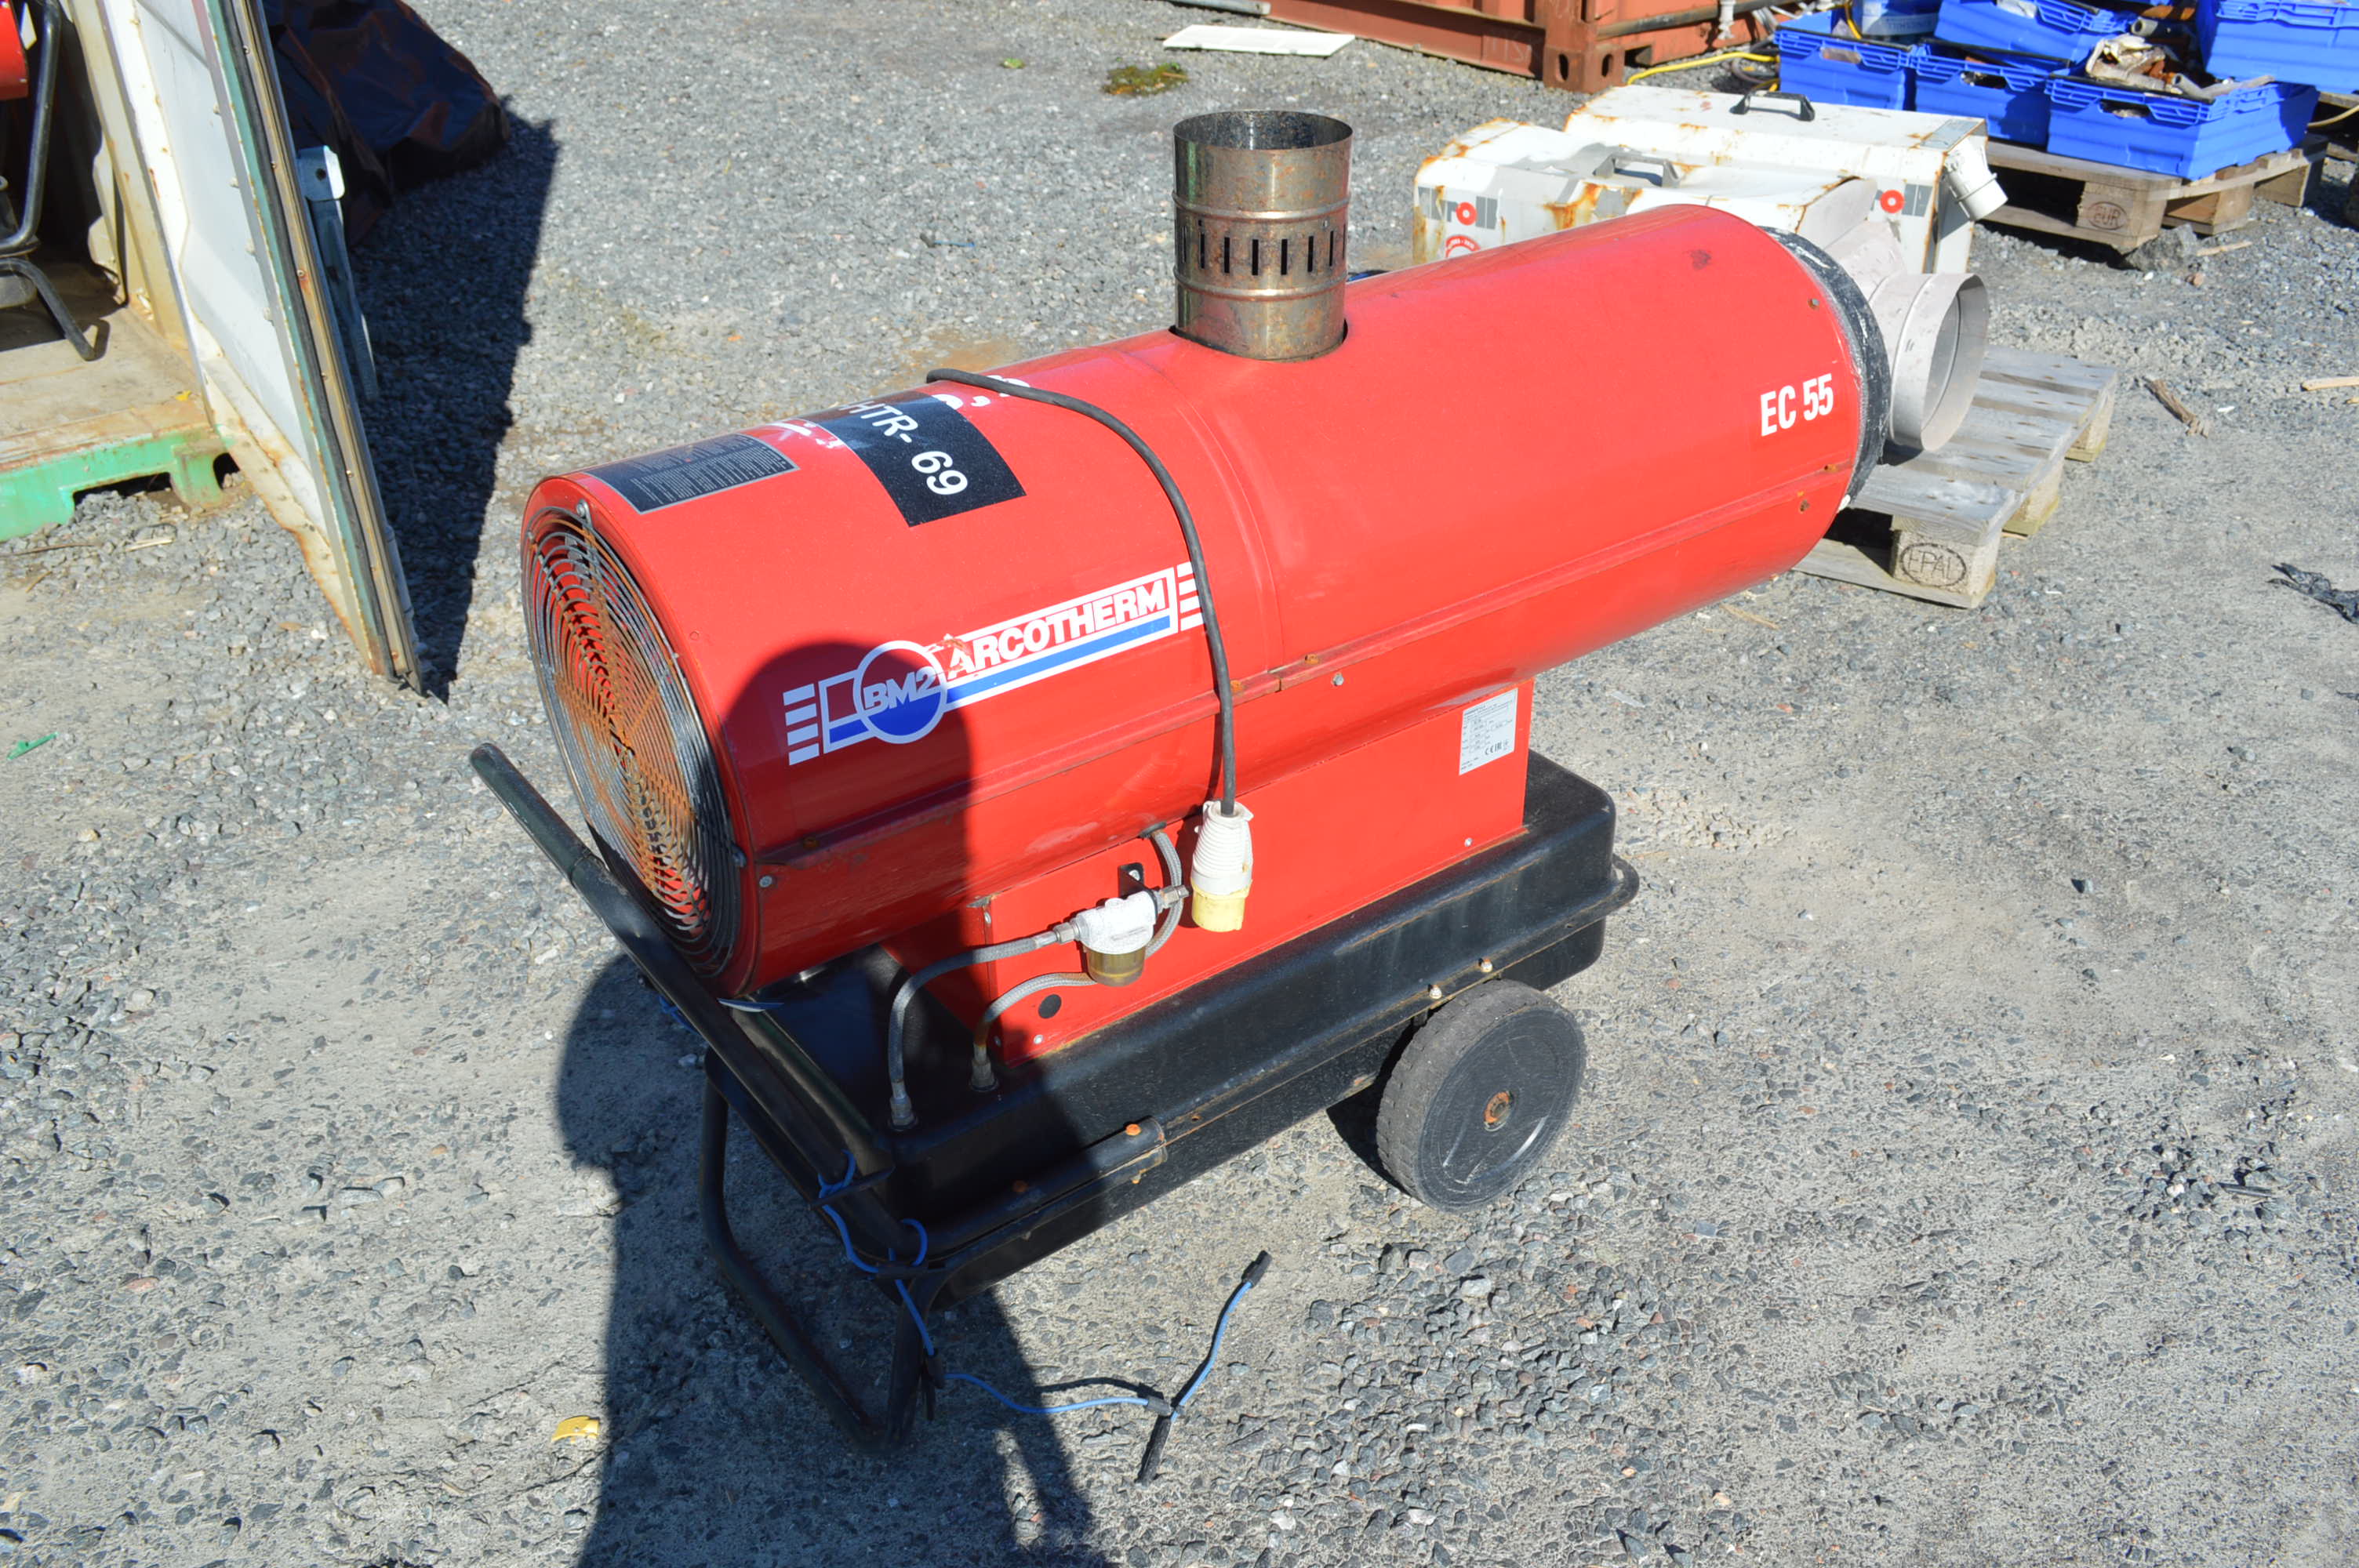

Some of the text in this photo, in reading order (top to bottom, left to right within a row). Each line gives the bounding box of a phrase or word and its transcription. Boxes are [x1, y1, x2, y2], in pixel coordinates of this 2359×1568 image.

[2094, 206, 2121, 227] EUR
[1761, 372, 1834, 437] EC 55
[911, 451, 968, 495] 69
[1908, 549, 1954, 579] EPAL
[863, 579, 1165, 710] BM2 ARCOTHERM
